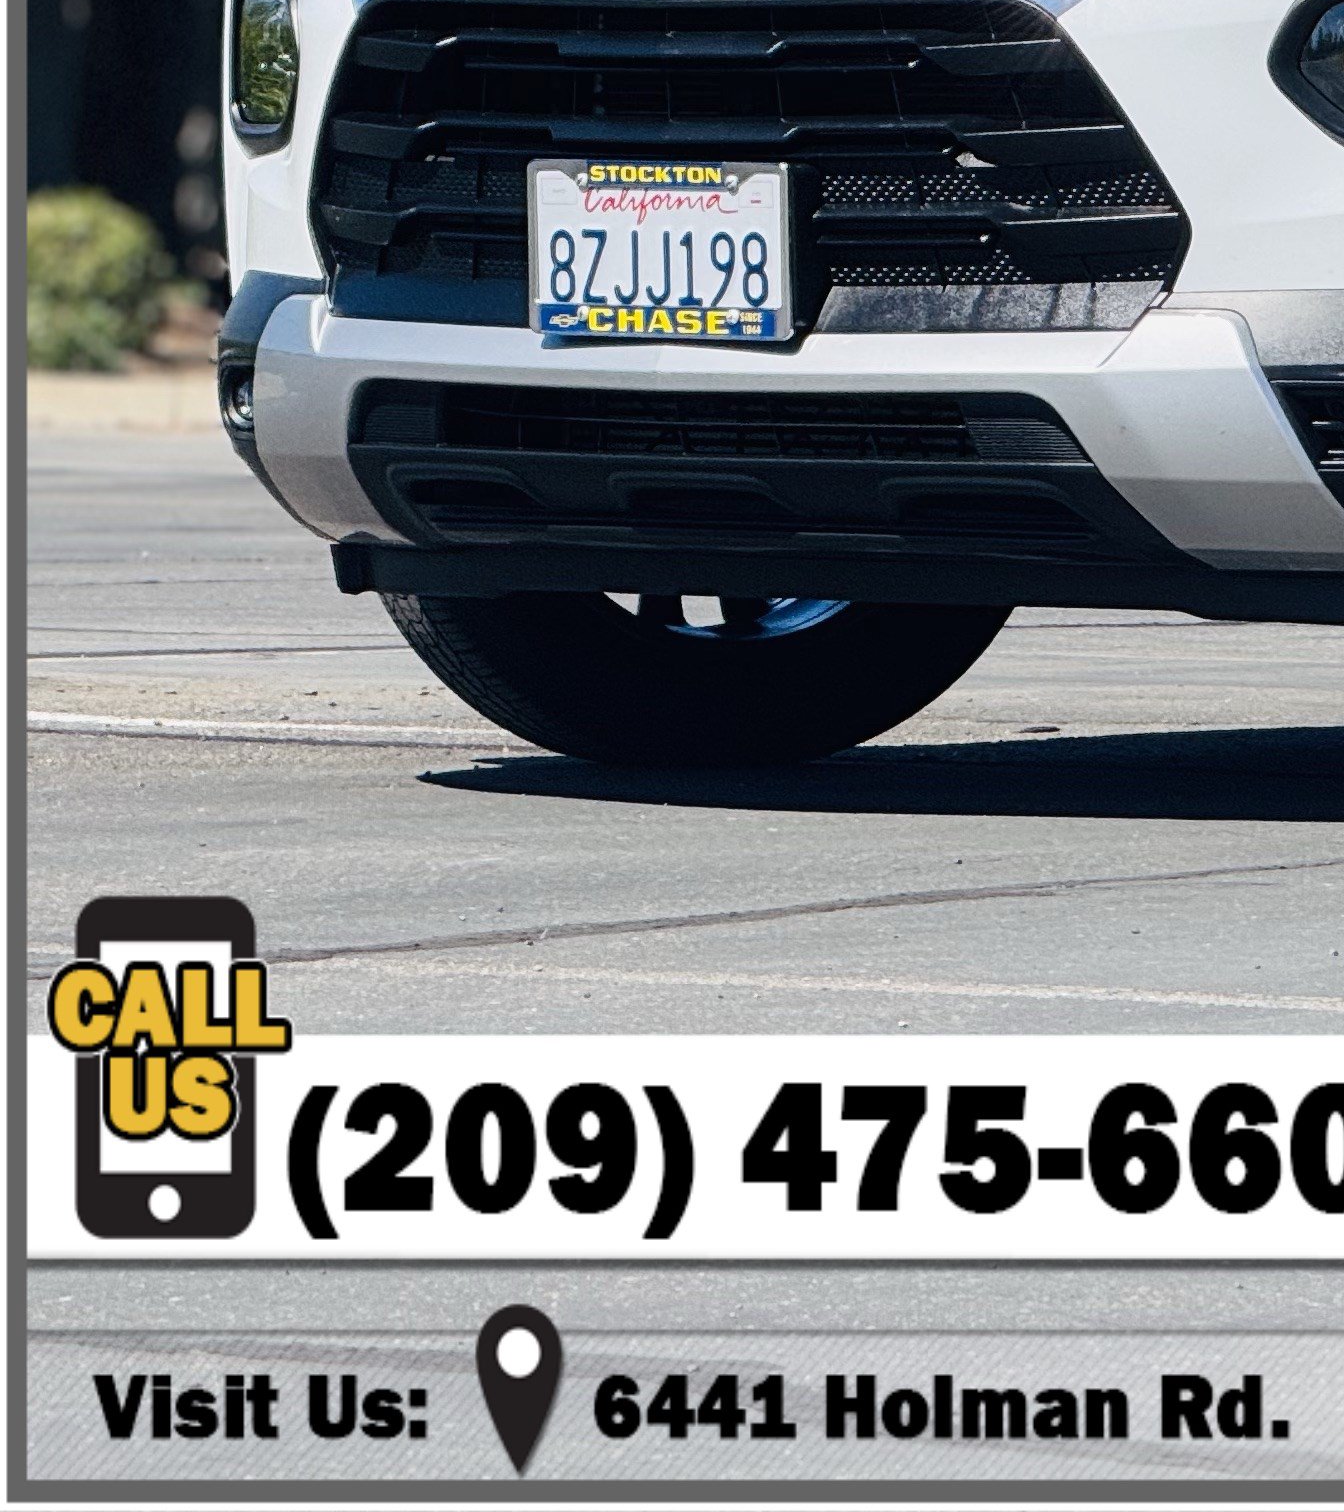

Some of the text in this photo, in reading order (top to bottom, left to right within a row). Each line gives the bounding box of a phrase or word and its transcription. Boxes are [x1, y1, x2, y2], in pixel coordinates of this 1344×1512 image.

[589, 165, 723, 185] STOCKTON
[582, 186, 738, 225] California
[549, 228, 769, 308] 8ZJJ198
[587, 308, 730, 335] CHASE
